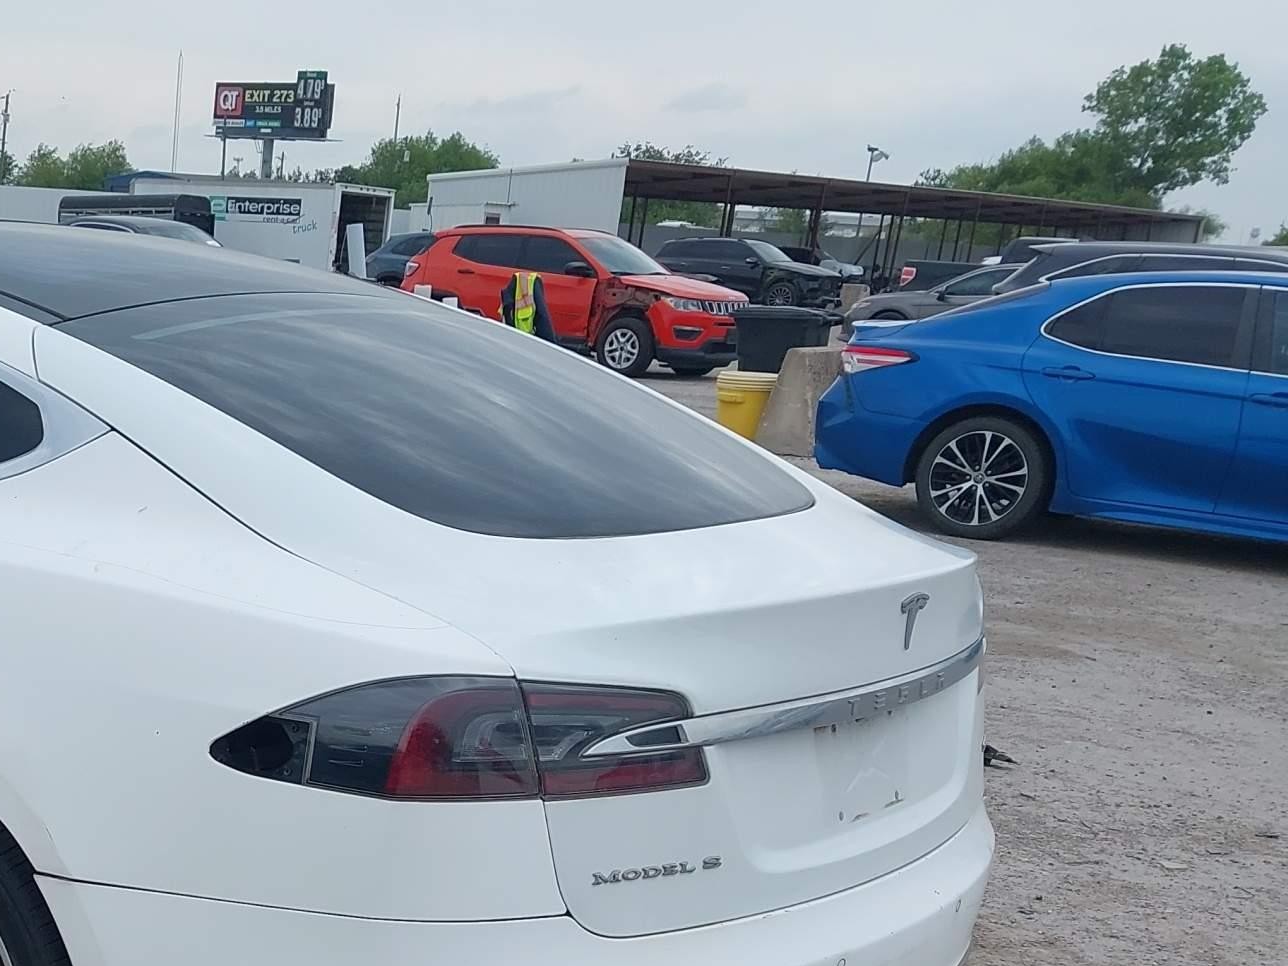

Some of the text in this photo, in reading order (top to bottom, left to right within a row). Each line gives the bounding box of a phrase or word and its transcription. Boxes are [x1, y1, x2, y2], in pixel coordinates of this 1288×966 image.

[220, 90, 239, 112] QT
[245, 90, 295, 103] EXIT 273
[264, 105, 282, 113] MILES
[228, 199, 300, 215] Enterprise
[292, 219, 318, 234] truck
[591, 855, 722, 886] MODEL S
